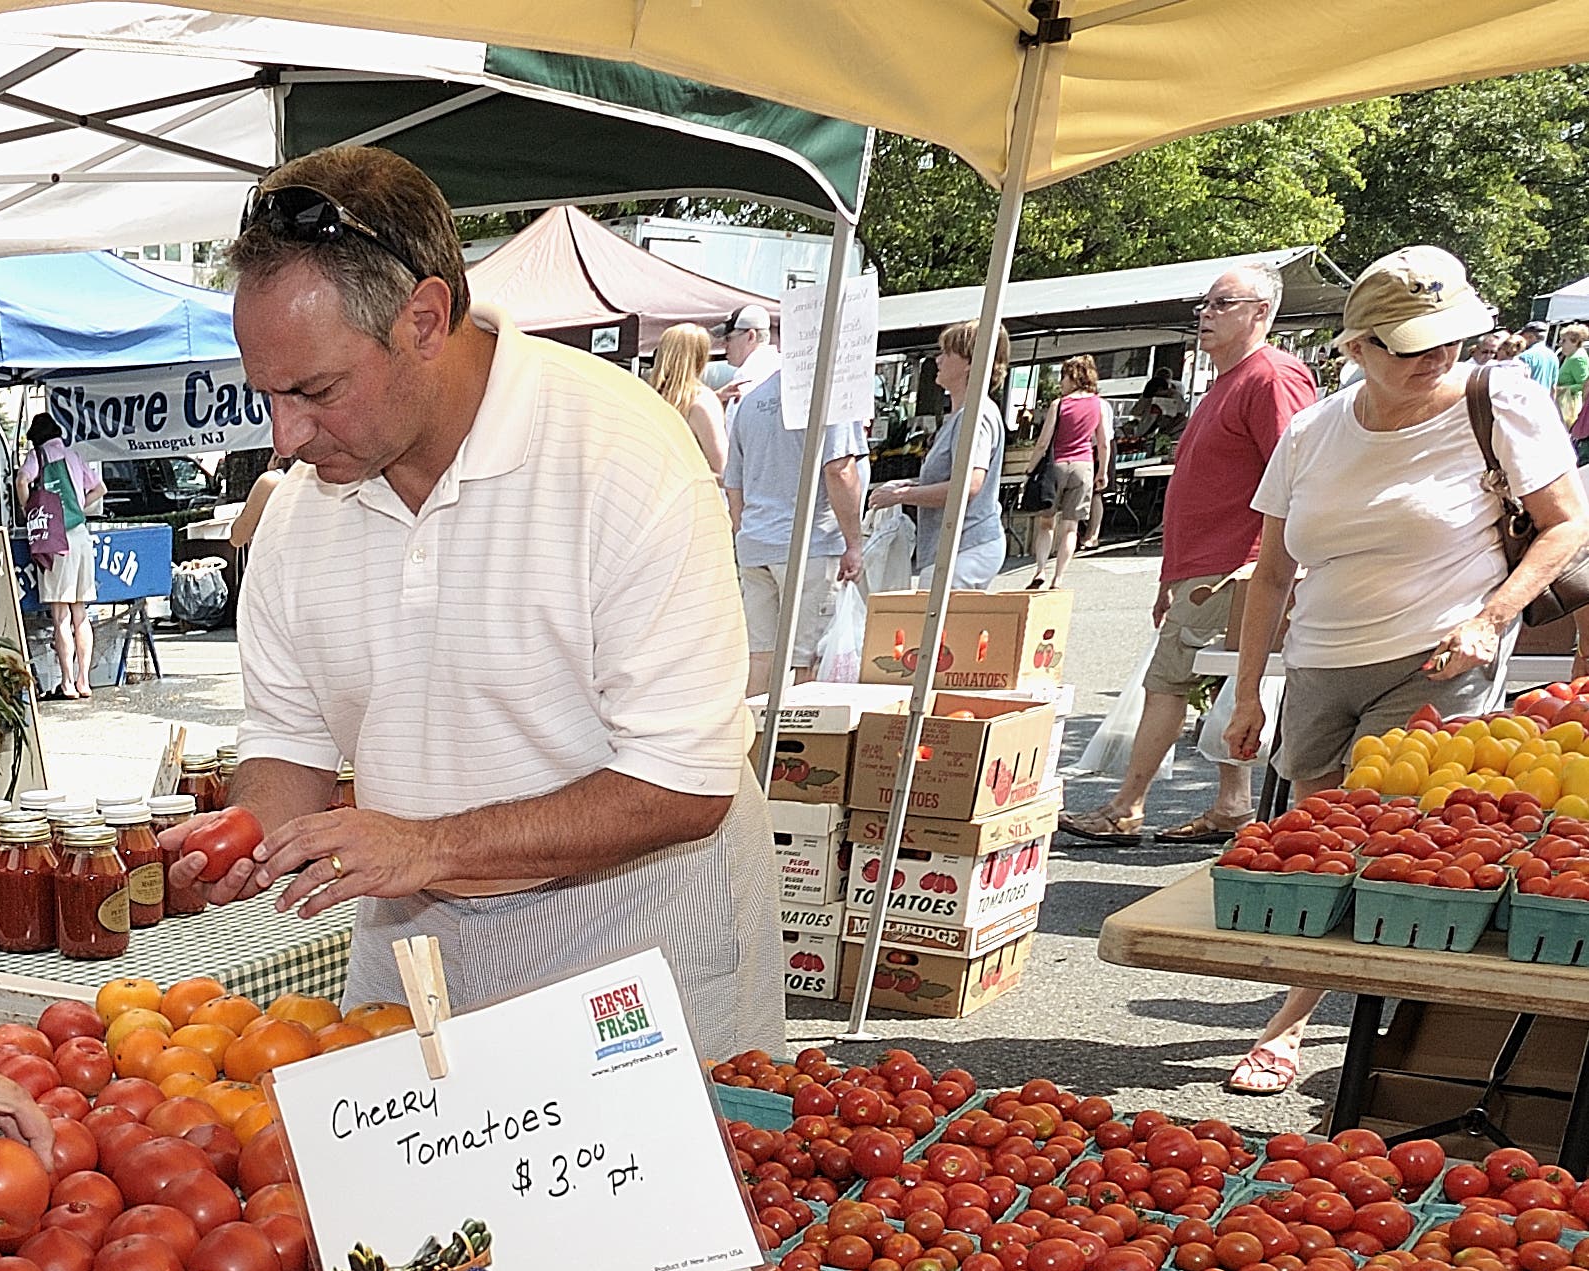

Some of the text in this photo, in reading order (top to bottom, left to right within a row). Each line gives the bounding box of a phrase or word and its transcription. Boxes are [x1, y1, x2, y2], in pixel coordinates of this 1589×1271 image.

[50, 385, 168, 448] Shore
[128, 431, 225, 451] Barnegat NJ
[944, 671, 1009, 689] TOMATOES
[794, 710, 820, 718] FARMS
[1007, 821, 1032, 839] SILK
[781, 866, 819, 876] TOMATOES
[854, 888, 958, 916] TOATOES
[977, 882, 1029, 914] TOMATOES
[589, 983, 641, 1018] JERSEY
[596, 1008, 650, 1042] FRESH
[397, 1101, 562, 1165] Tomatoes
[607, 1153, 644, 1196] pt.
[681, 1260, 688, 1268] of
[706, 1253, 728, 1262] Jersey
[729, 1248, 744, 1257] USA
